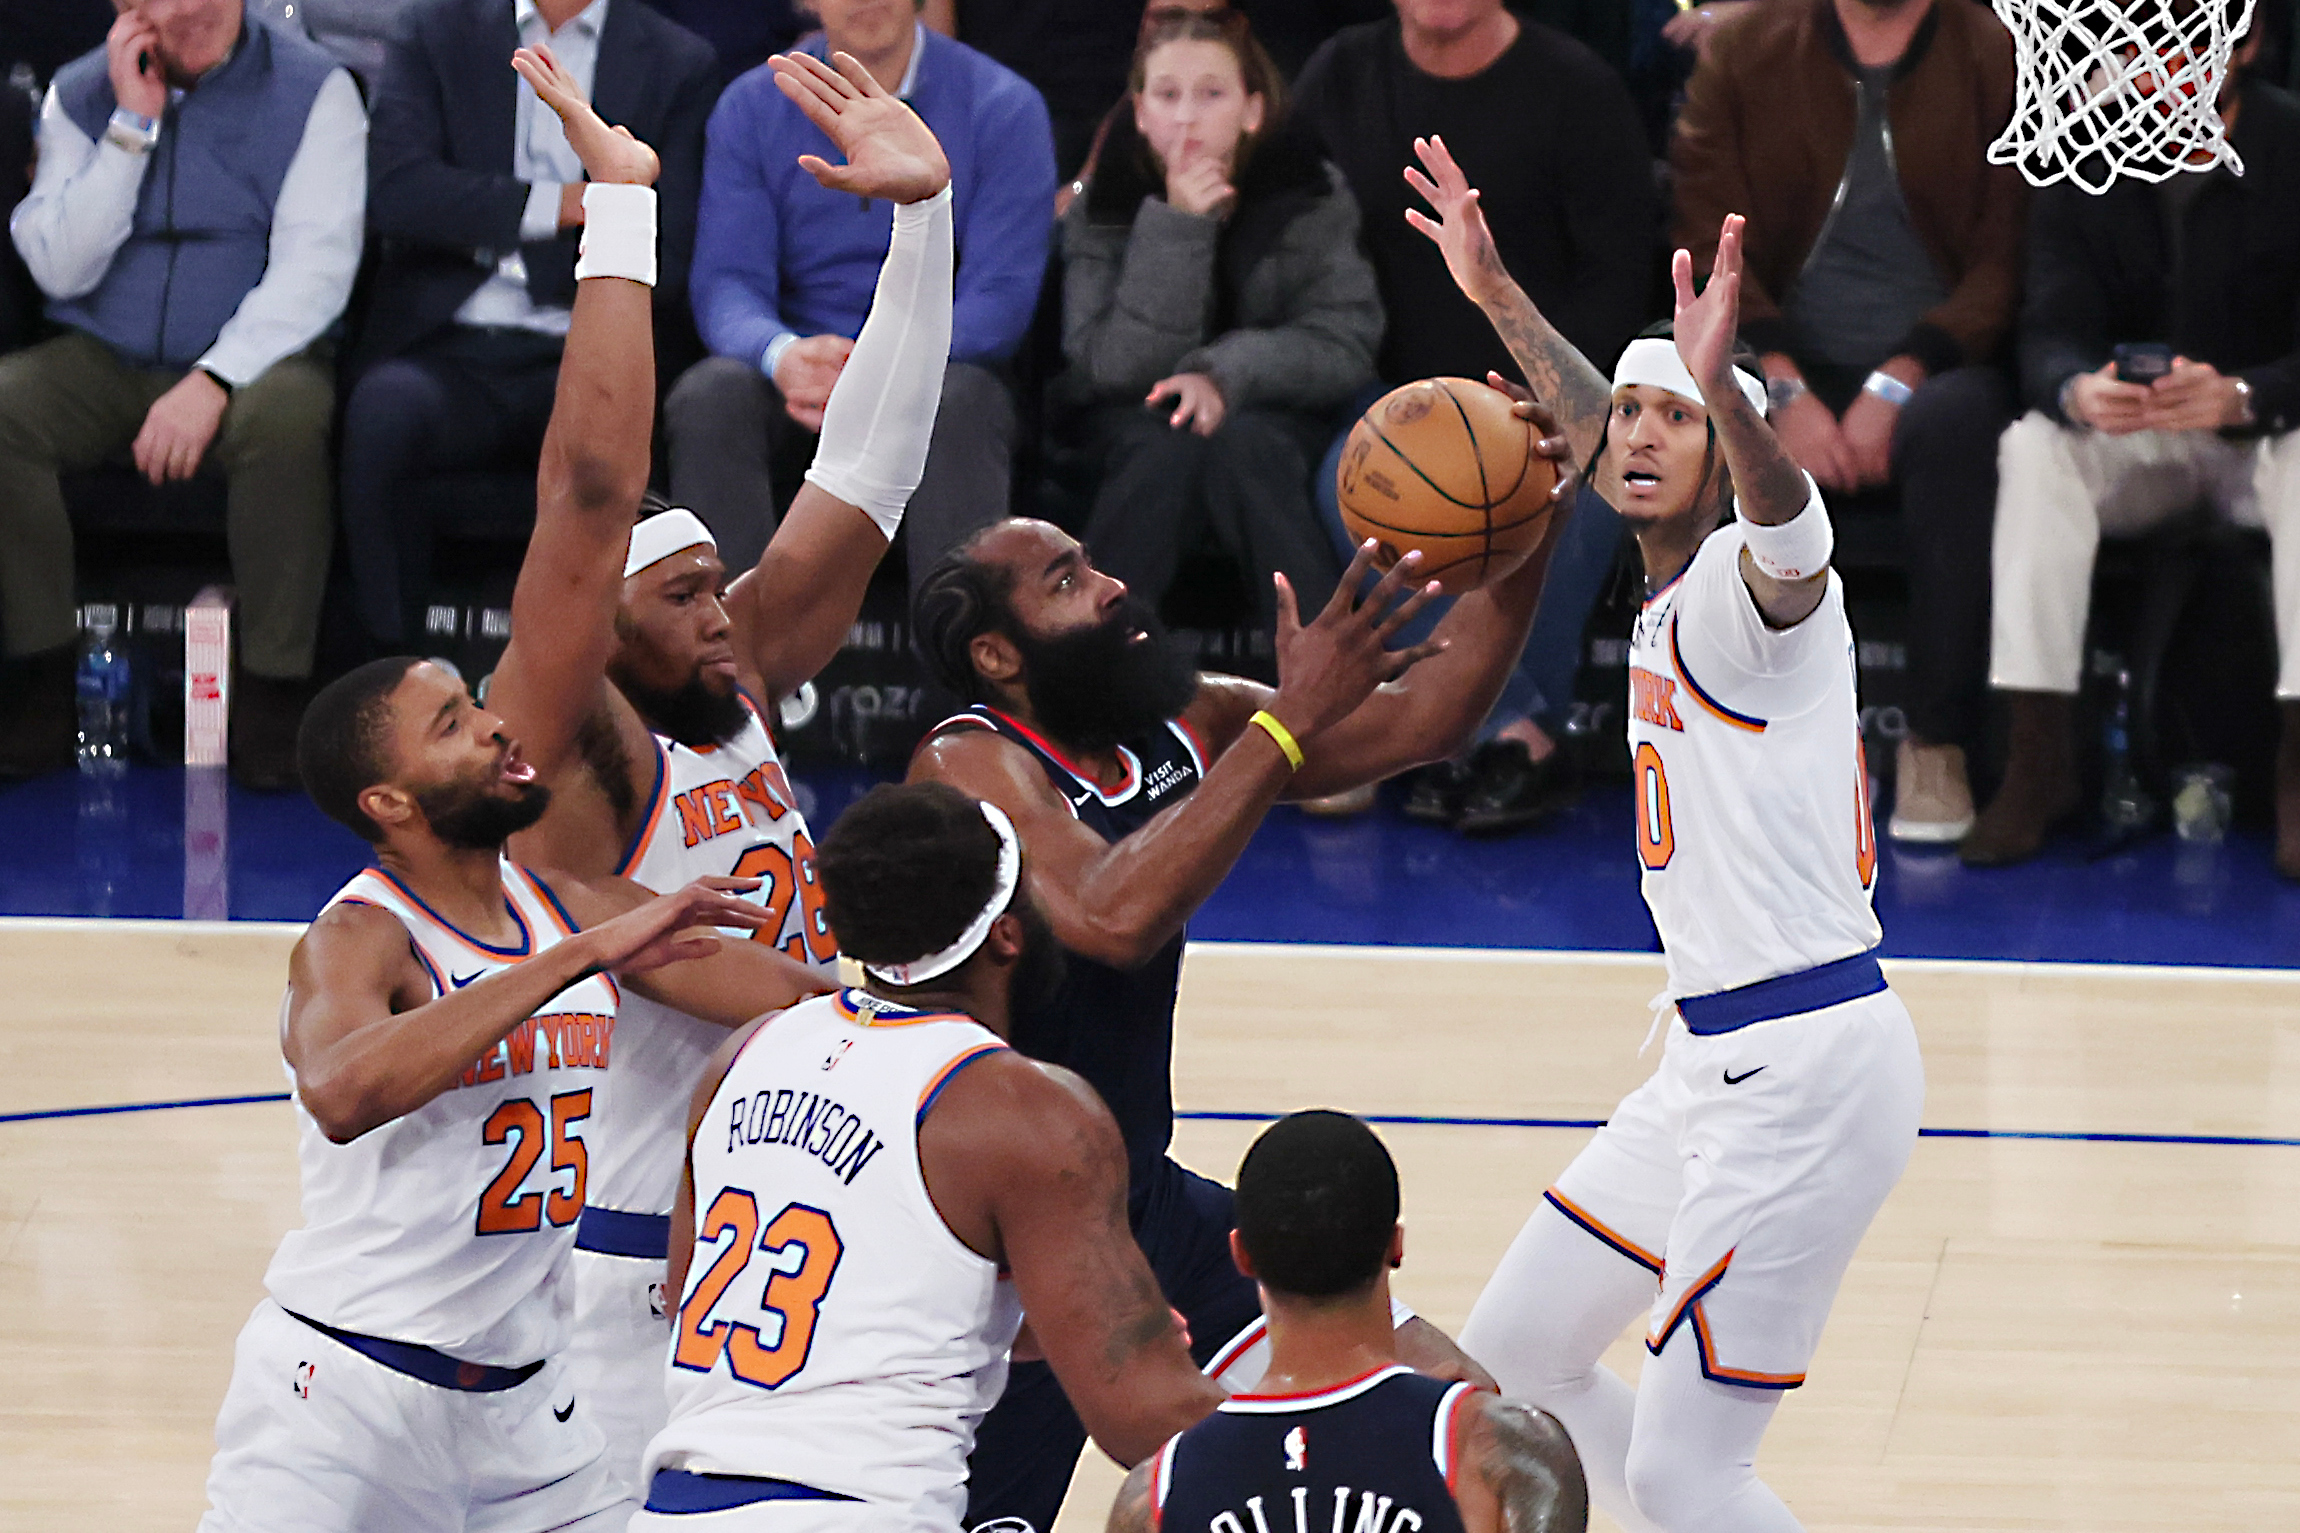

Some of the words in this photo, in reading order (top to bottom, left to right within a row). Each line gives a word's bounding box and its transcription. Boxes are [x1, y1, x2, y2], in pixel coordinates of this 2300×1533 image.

[1144, 760, 1175, 786] VISIT
[1147, 765, 1193, 801] WANDA
[540, 1012, 616, 1071] YORK
[475, 1087, 593, 1237] 25
[727, 1089, 884, 1186] ROBINSON
[673, 1186, 844, 1391] 23
